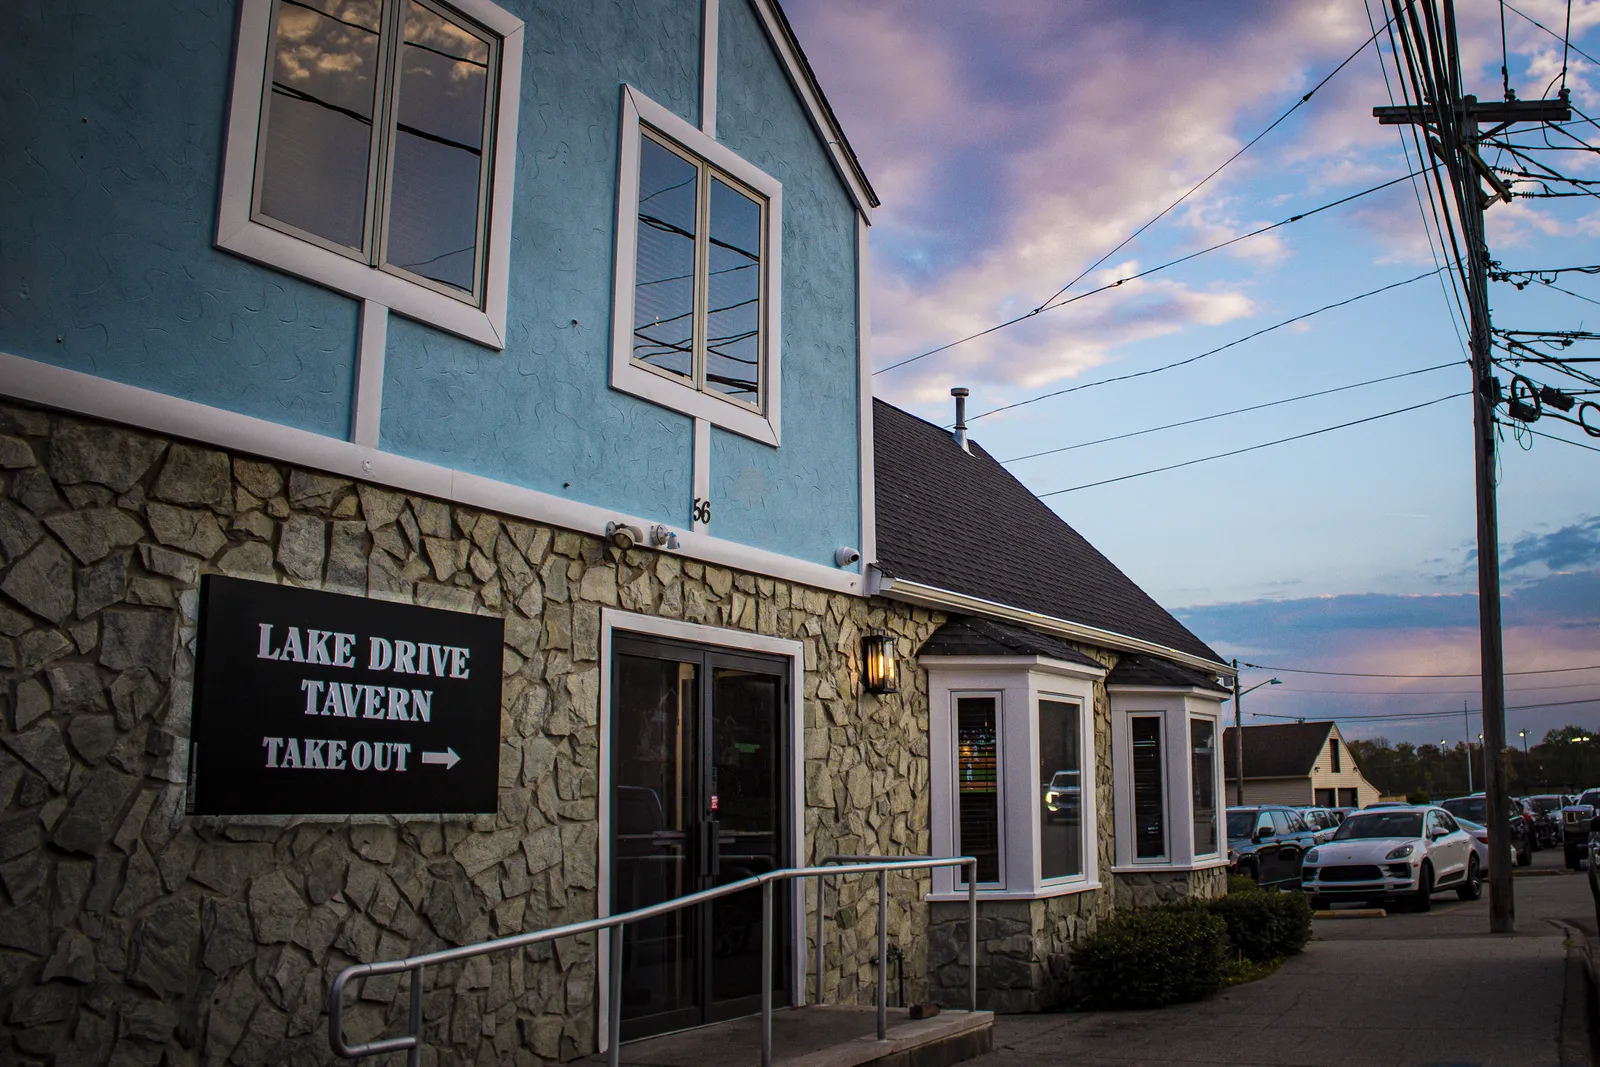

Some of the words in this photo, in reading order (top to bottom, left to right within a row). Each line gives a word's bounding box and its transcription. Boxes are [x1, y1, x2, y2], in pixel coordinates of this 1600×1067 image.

[693, 497, 711, 525] 56
[257, 622, 357, 669] LAKE
[367, 636, 471, 680] DRIVE
[301, 679, 434, 723] TAVERN
